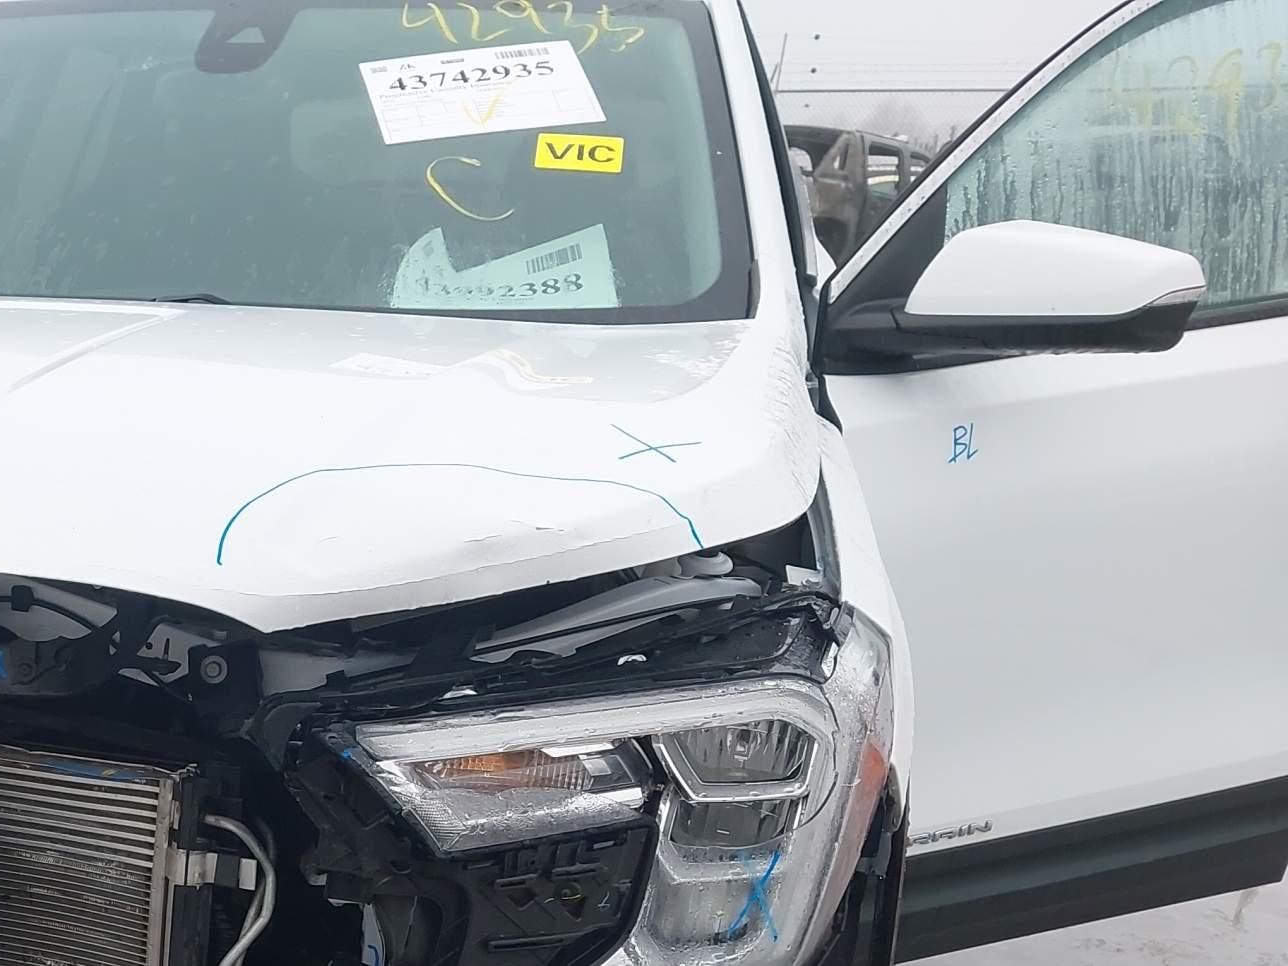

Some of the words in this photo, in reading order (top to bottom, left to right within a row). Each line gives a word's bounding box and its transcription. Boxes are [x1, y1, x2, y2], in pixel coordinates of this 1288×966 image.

[401, 0, 646, 54] 42935
[388, 60, 555, 92] 43742935
[545, 142, 616, 164] VIC
[948, 423, 979, 463] BL
